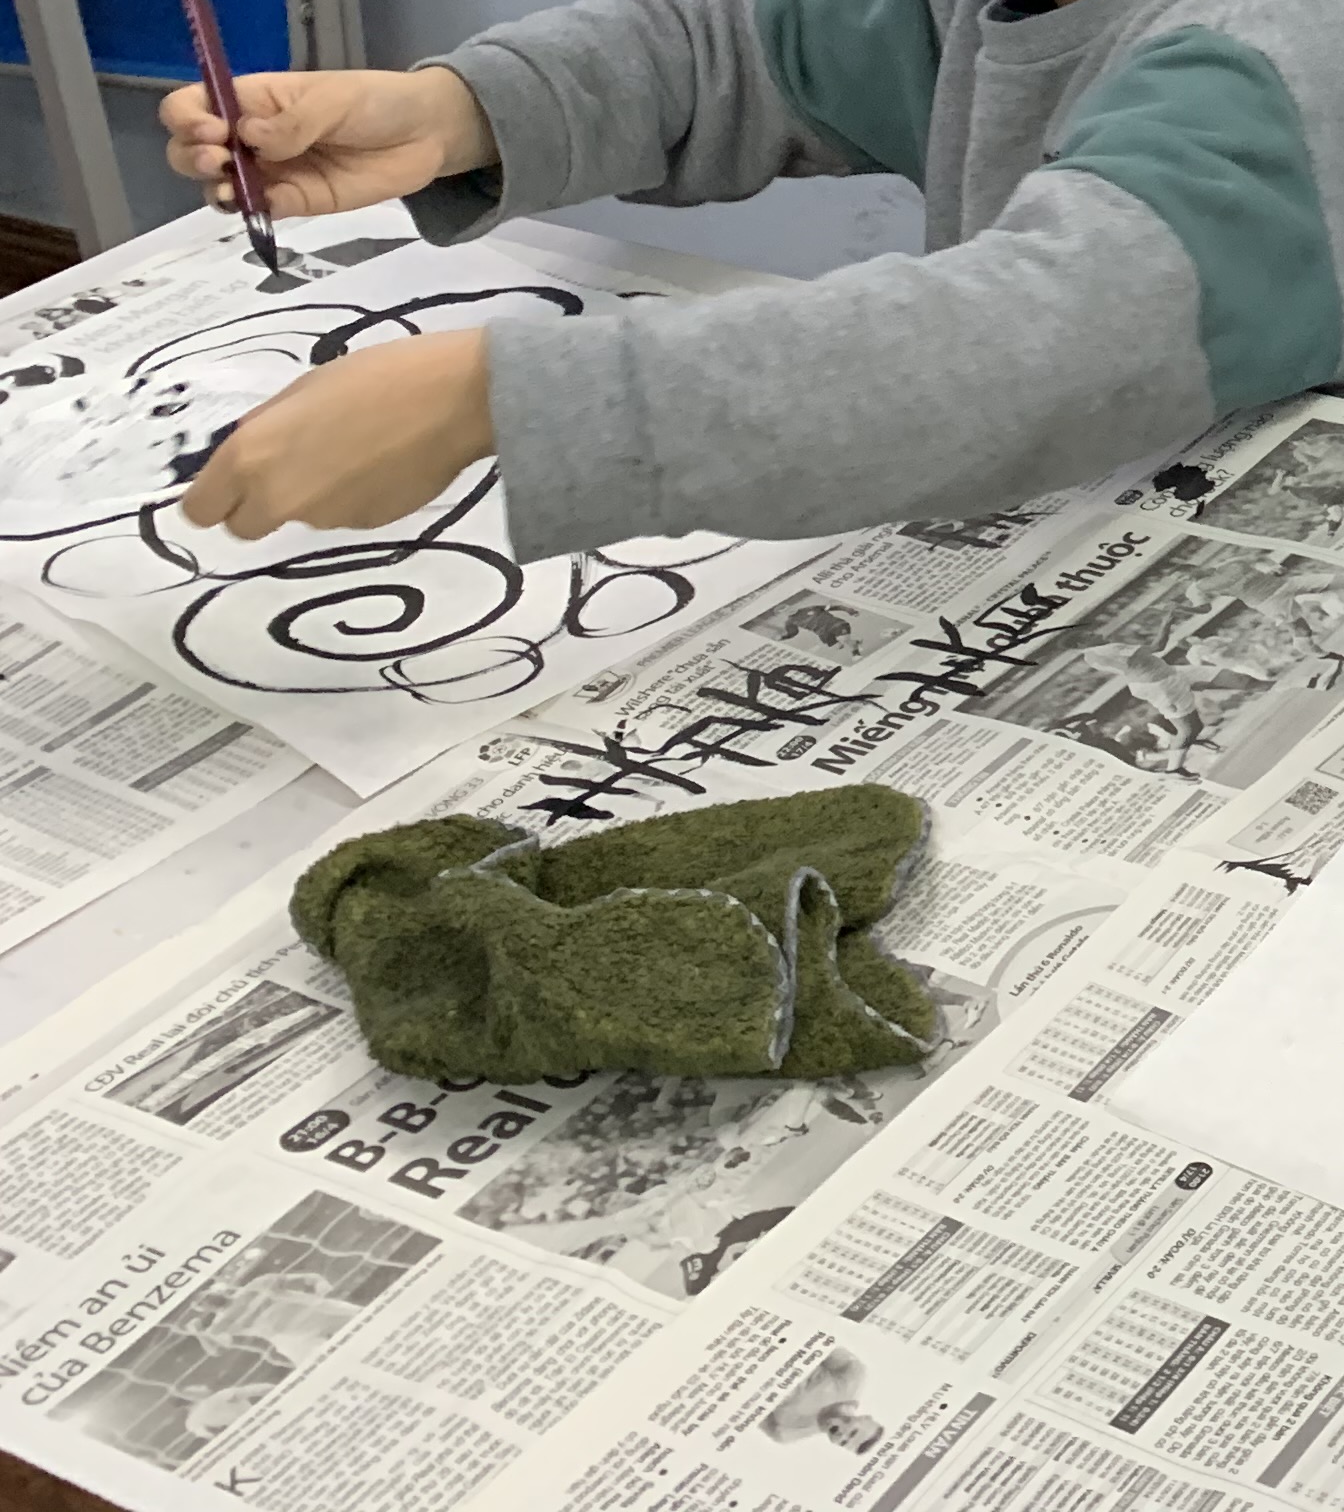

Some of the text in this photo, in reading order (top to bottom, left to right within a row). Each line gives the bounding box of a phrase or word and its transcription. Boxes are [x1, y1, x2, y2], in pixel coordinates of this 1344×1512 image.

[846, 541, 900, 572] Arsenal
[1055, 529, 1158, 593] thuộc
[608, 673, 682, 718] Wilshere
[504, 746, 539, 766] LFP
[470, 796, 508, 818] cho
[496, 770, 543, 798] danh
[1039, 924, 1091, 959] Ronaldo
[78, 1063, 130, 1093] CĐV
[120, 1038, 167, 1065] Real
[377, 1089, 561, 1199] Real
[1176, 1164, 1198, 1183] 17/4
[69, 1225, 259, 1355] Benzema
[70, 1277, 134, 1316] an
[1302, 1373, 1334, 1402] Không
[946, 1405, 979, 1431] TIN
